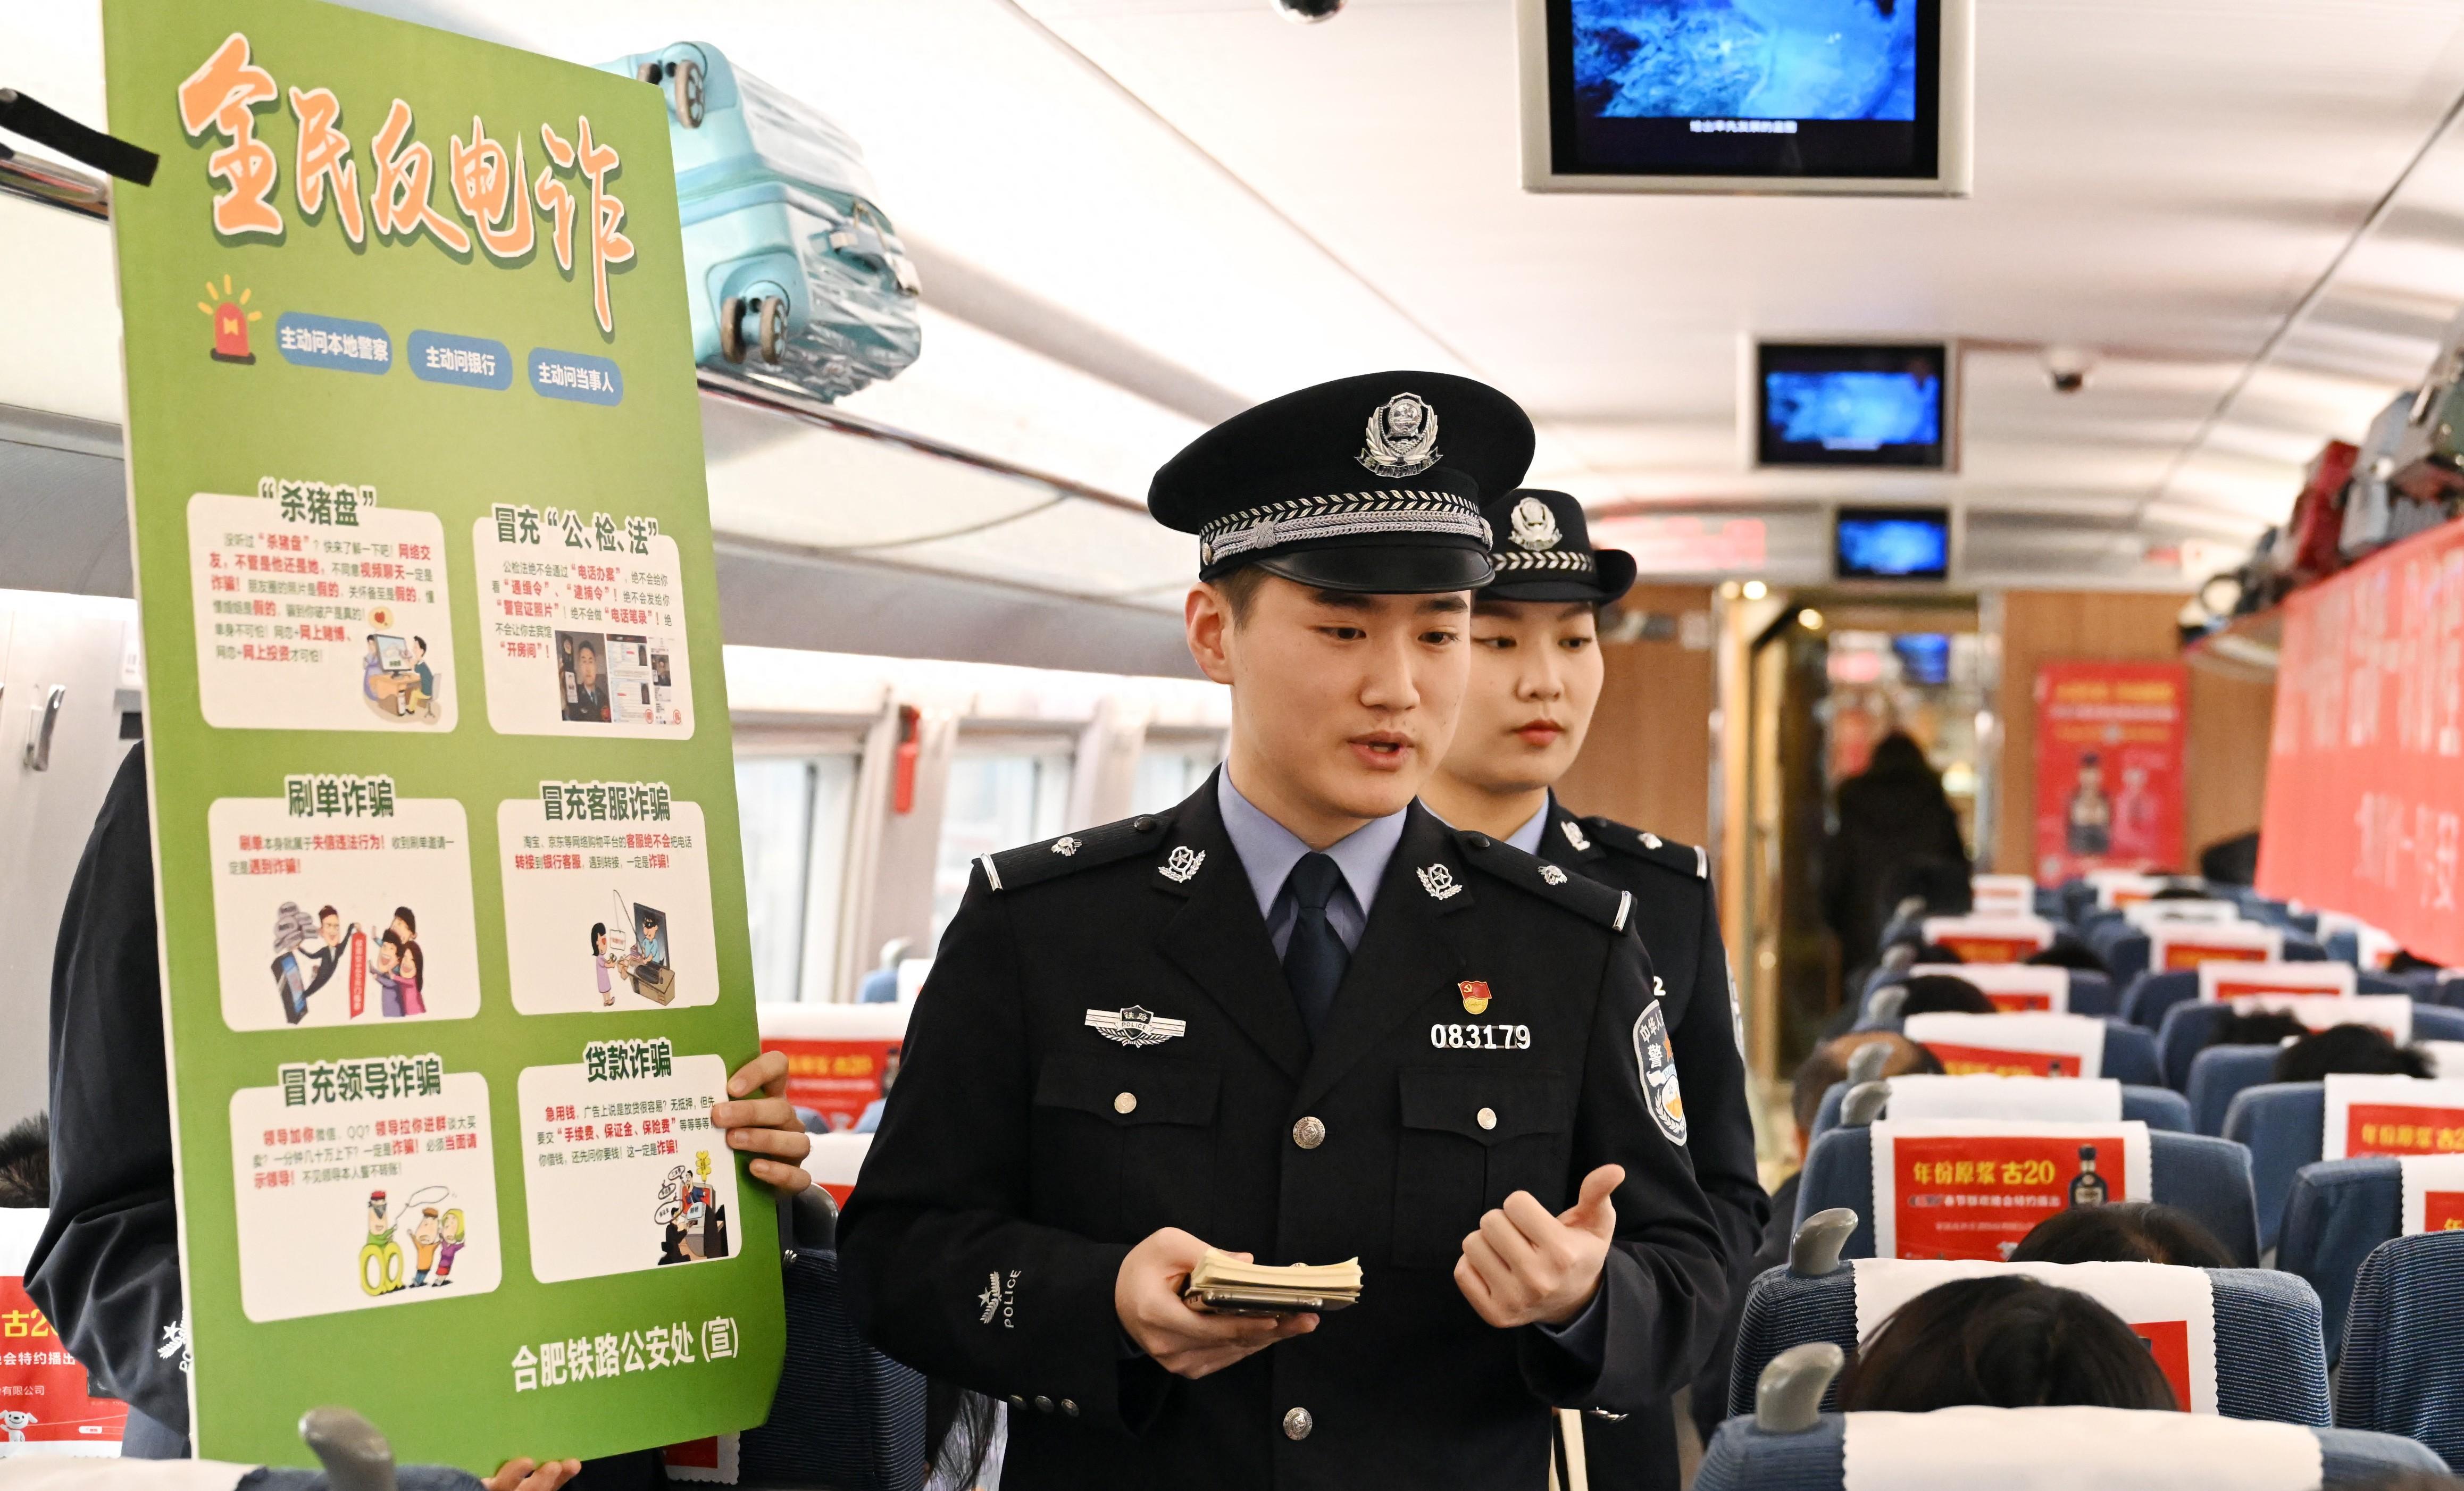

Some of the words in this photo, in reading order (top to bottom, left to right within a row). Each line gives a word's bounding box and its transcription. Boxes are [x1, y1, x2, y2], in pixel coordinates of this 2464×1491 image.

[178, 32, 634, 333] 全民反电诈
[281, 326, 389, 363] 主动问本地警察
[426, 346, 496, 376] 主动问银行
[538, 362, 614, 394] 主动问当事人
[262, 482, 374, 526] “杀猪盘”
[495, 507, 658, 556] 冒充“公、检、法”
[495, 623, 553, 638] 不会让你去宾馆
[288, 779, 394, 817] 刷单诈骗
[542, 785, 671, 821] 冒充客服诈骗
[1124, 1011, 1148, 1021] 铁路
[1640, 1010, 1664, 1043] 中华人
[1431, 1024, 1531, 1049] 083179
[585, 1042, 672, 1083] 贷款诈骗
[282, 1058, 441, 1107] 冒充领导诈骗
[1914, 1160, 1996, 1185] 年份原浆
[2002, 1160, 2055, 1185] 古20
[1004, 1270, 1021, 1328] POLICE
[2, 1309, 59, 1337] 古2
[0, 1352, 76, 1366] 会特约播出
[0, 1385, 45, 1396] 有限公司
